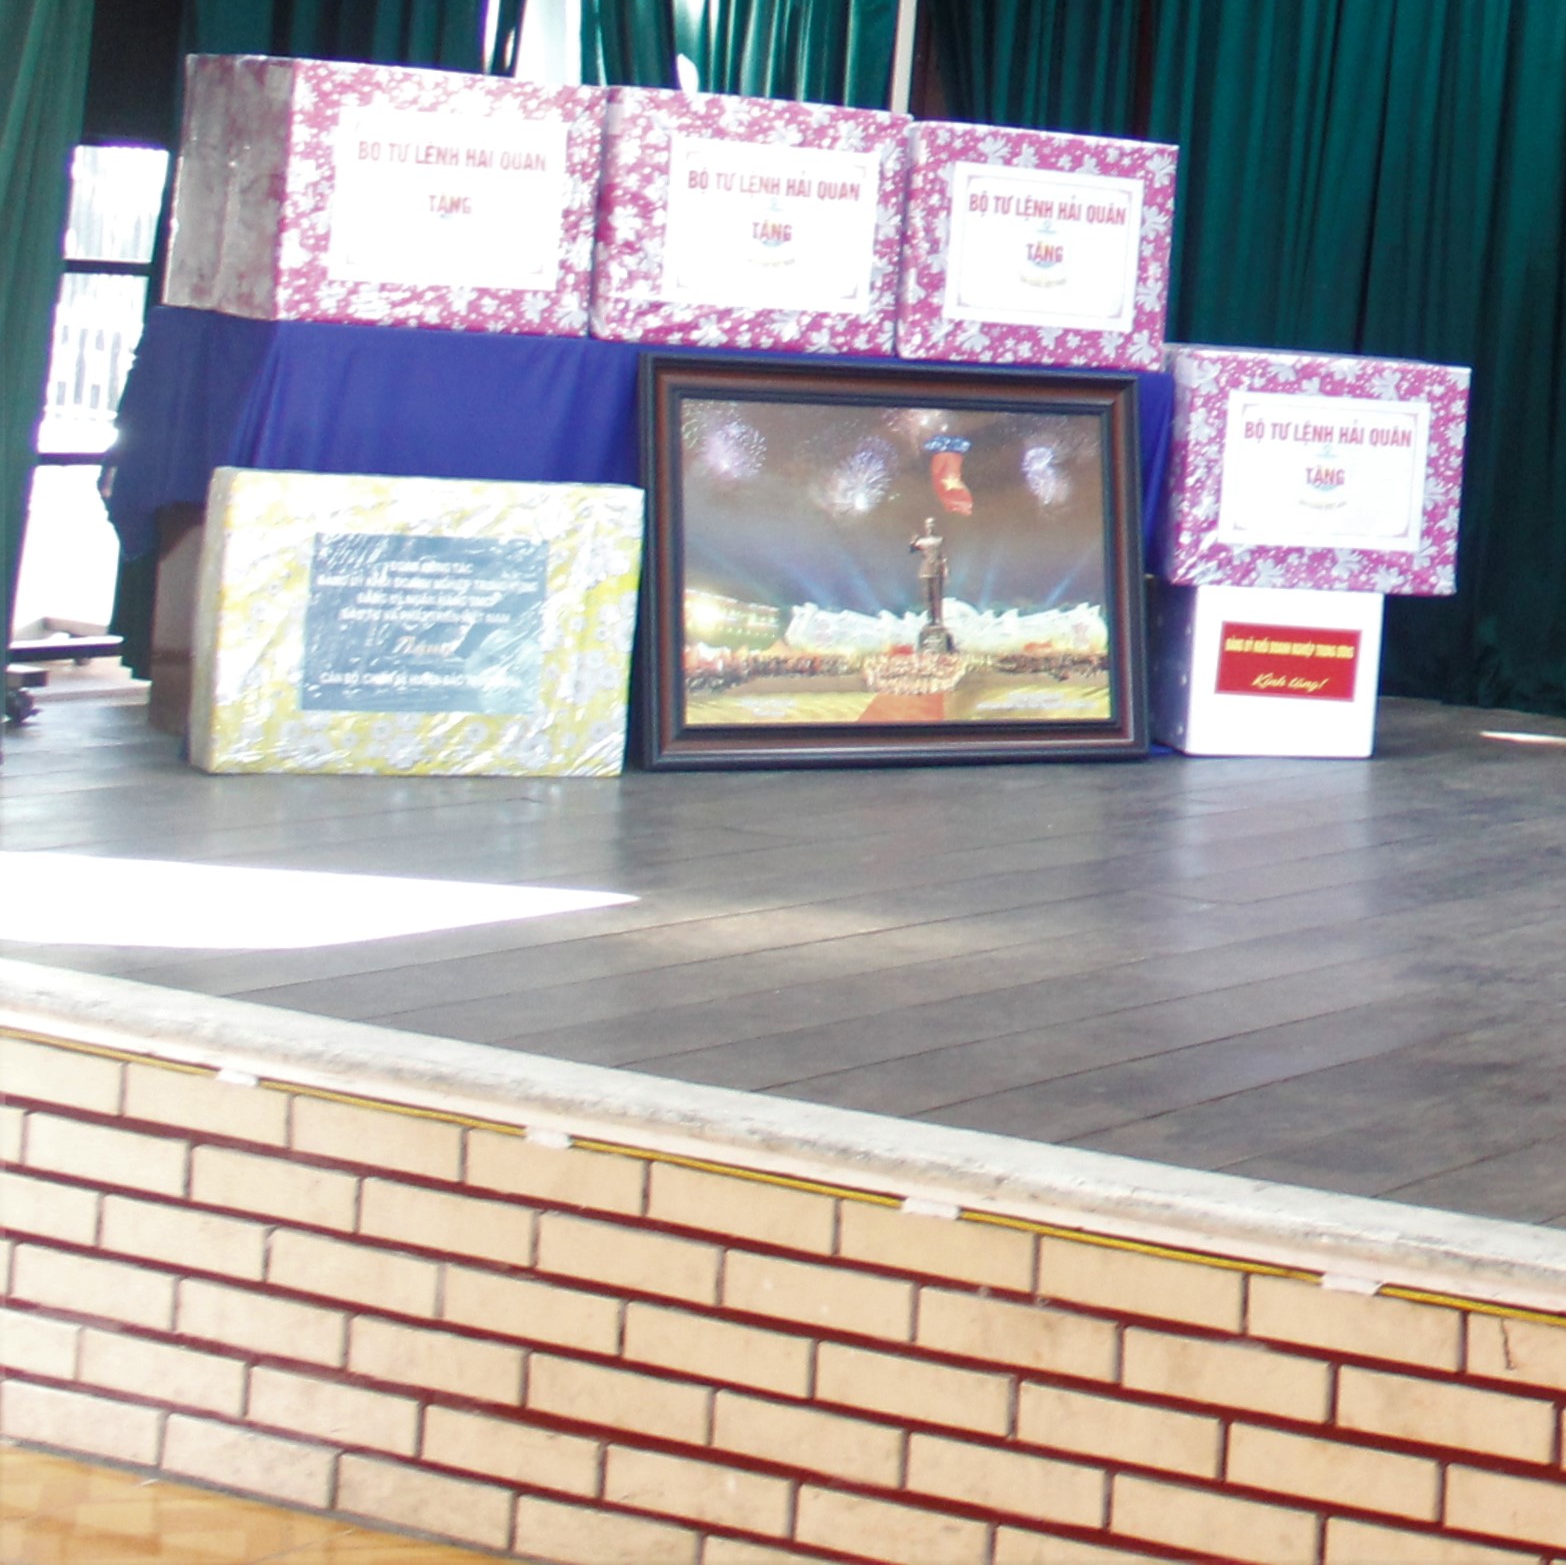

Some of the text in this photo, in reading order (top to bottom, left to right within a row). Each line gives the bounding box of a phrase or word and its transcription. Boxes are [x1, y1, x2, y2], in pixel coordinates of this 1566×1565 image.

[968, 190, 1127, 226] BỘ TƯ LỆNH HẢI QUÂN
[1244, 418, 1412, 448] BỘ TƯ LỆNH HẢI QUÂN
